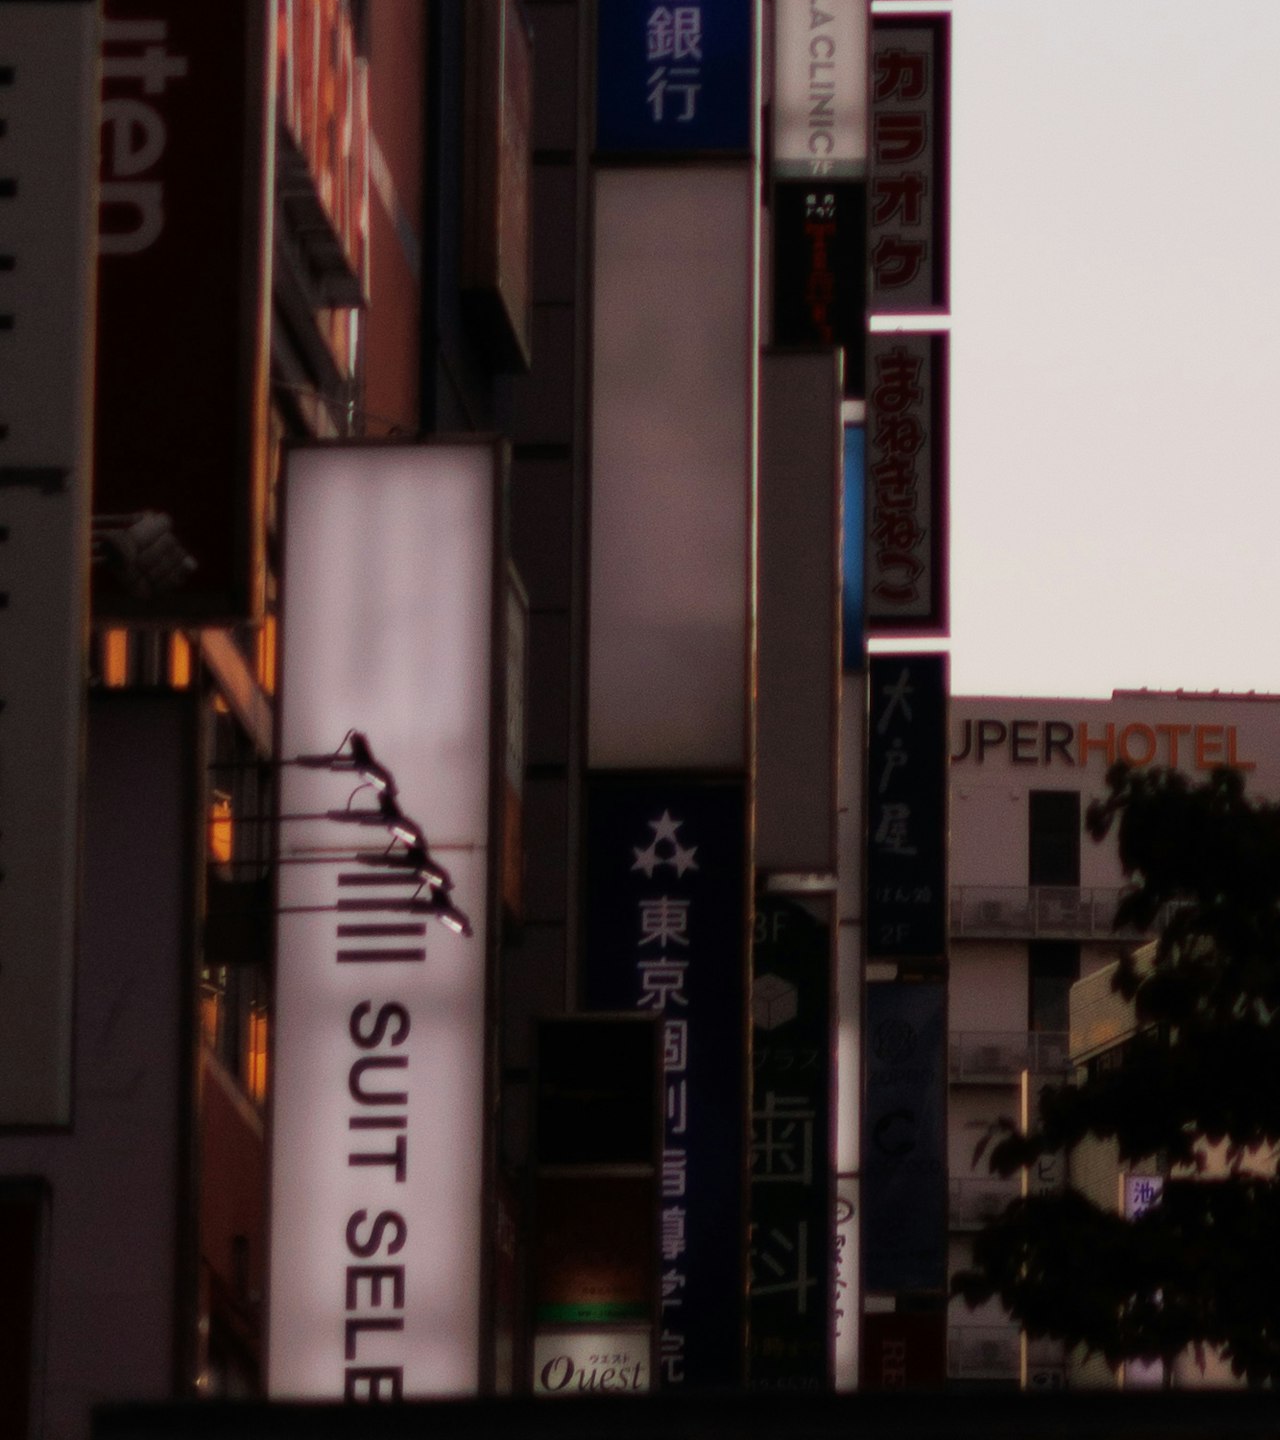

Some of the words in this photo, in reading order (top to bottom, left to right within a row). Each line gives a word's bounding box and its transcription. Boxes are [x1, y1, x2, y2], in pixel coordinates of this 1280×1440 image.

[873, 45, 926, 292] カラオケ
[871, 345, 926, 607] まねきねこ
[876, 666, 918, 856] 大戸屋
[347, 999, 413, 1184] SUIT
